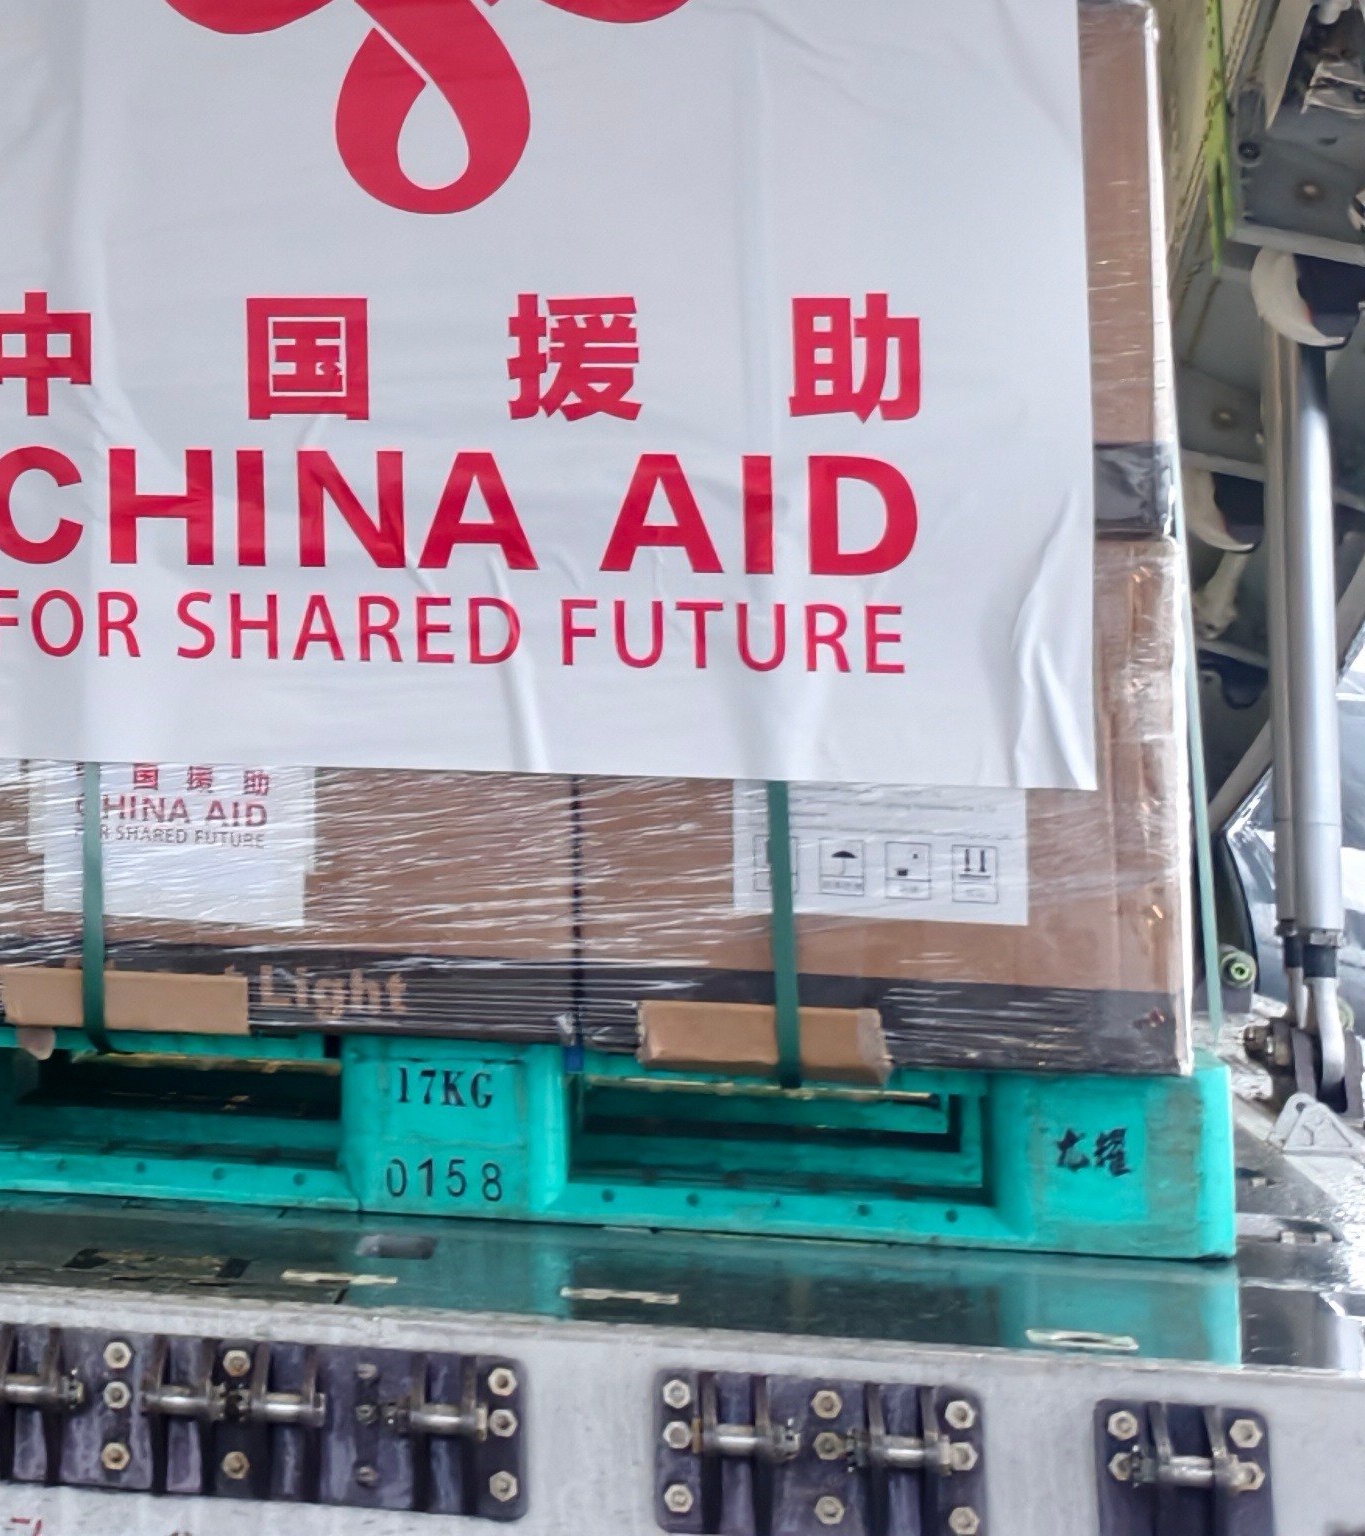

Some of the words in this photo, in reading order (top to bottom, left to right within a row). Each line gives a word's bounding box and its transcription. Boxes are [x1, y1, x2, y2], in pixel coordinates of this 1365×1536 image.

[600, 452, 919, 576] AID
[176, 590, 522, 665] SHARED
[561, 598, 906, 674] FUTURE
[116, 825, 188, 844] SHARED
[195, 830, 265, 848] FUTURE
[206, 800, 268, 827] AID
[260, 963, 407, 1020] Light
[397, 1066, 494, 1111] 17KG
[385, 1157, 504, 1204] 0158
